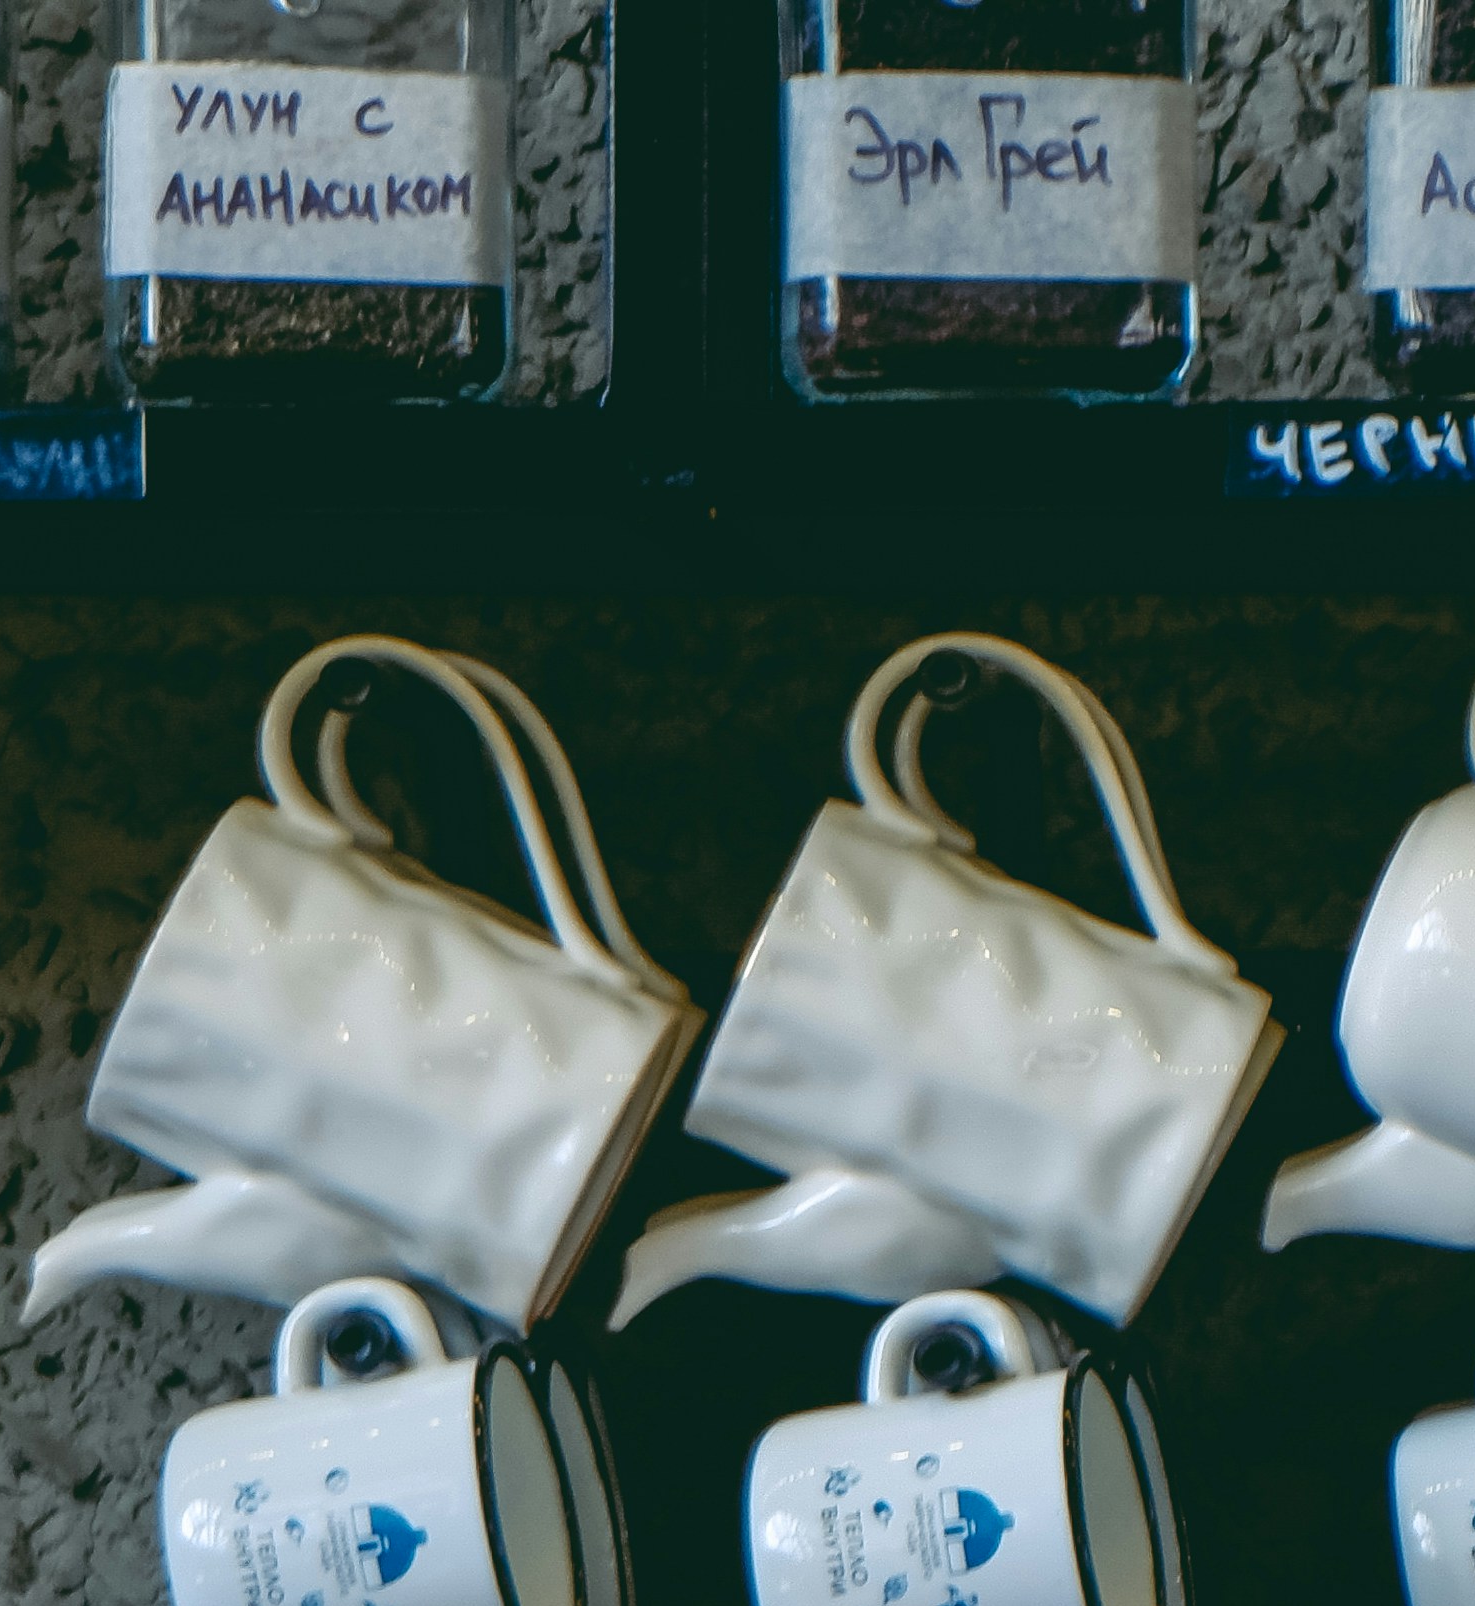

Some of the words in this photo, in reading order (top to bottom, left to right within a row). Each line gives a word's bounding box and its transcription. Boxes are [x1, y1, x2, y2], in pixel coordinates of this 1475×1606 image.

[171, 82, 302, 138] УЛУН
[844, 106, 963, 207] Эрл
[978, 93, 1114, 213] Грей
[154, 168, 474, 227] АНАНАСИКОМ
